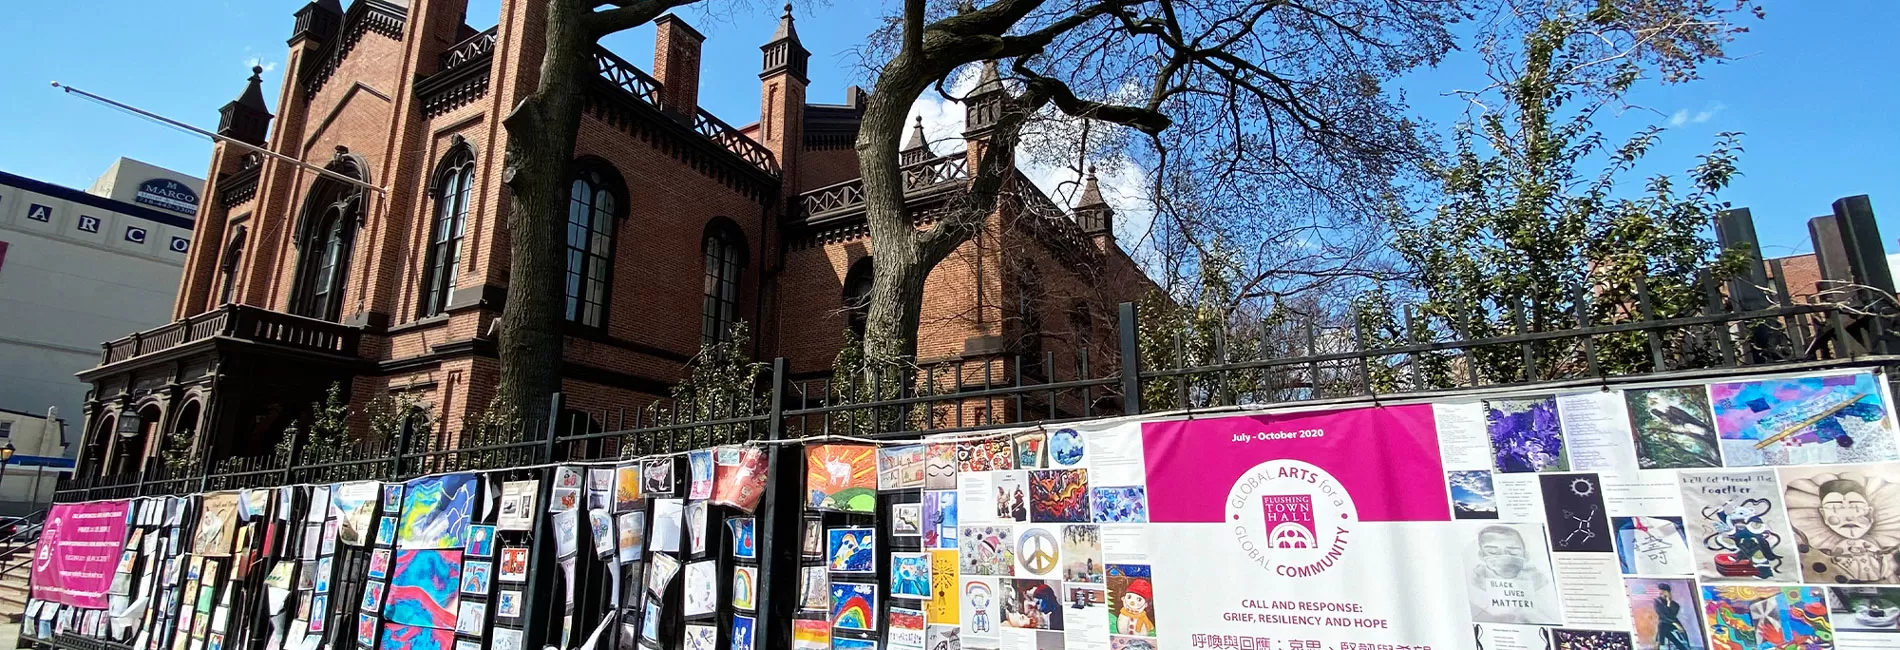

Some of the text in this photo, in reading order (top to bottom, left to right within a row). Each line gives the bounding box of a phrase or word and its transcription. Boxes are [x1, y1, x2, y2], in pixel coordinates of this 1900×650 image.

[146, 184, 195, 203] MARCO
[1231, 433, 1250, 443] July
[1257, 430, 1297, 441] October
[1298, 429, 1324, 439] 2020
[1231, 466, 1344, 509] GLOBAL ARTS for a
[1264, 496, 1309, 504] FLUSHING
[1265, 503, 1309, 512] TOWN
[1268, 512, 1311, 521] HALL
[1234, 525, 1350, 578] GLOBAL COMMUNITY
[1490, 580, 1513, 588] BLACK
[1241, 599, 1363, 613] CALL AND RESPONSE:
[1223, 612, 1388, 629] GRIEF, RESILIENCY AND HOPE
